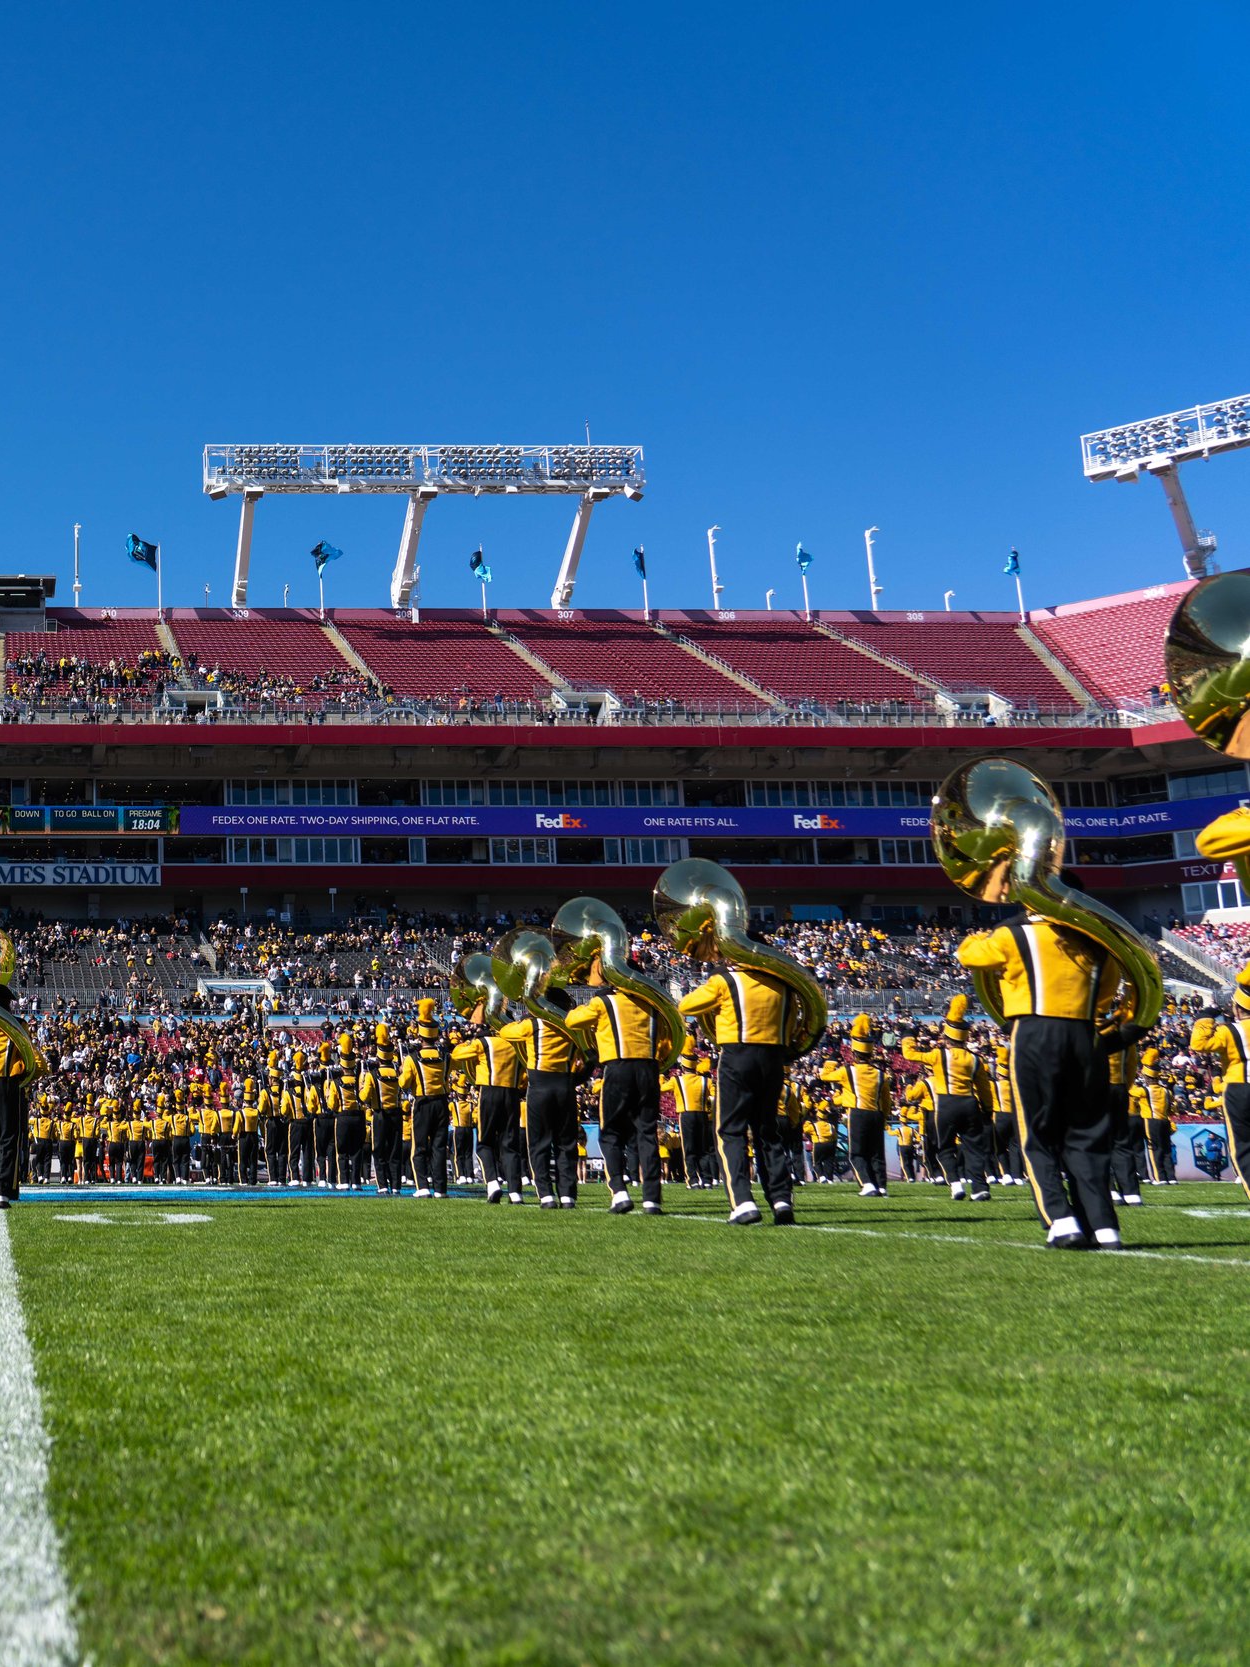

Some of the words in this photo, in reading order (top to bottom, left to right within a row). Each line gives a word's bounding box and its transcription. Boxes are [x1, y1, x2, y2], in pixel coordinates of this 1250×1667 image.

[101, 609, 117, 617] 310
[233, 609, 249, 618] 309
[396, 610, 412, 618] 308
[557, 611, 574, 619] 307
[718, 611, 736, 619] 306
[906, 612, 924, 620] 305
[15, 810, 40, 818] DOWN
[54, 810, 64, 818] TO
[66, 810, 77, 818] GO
[82, 810, 102, 818] BALL
[103, 810, 115, 818] ON
[129, 810, 162, 818] PREGAME
[132, 819, 161, 830] 18:04
[212, 816, 244, 824] FEDEX
[247, 816, 268, 824] ONE
[271, 816, 298, 824] RATE.
[300, 816, 348, 824] TWO-DAY
[351, 816, 400, 826] SHIPPING,
[402, 816, 424, 825] ONE
[426, 816, 449, 825] FLAT
[452, 816, 480, 825] RATE.
[536, 813, 581, 828] FedEx
[644, 818, 665, 826] ONE
[668, 818, 693, 826] RATE
[695, 818, 715, 826] FITS
[717, 818, 739, 826] ALL.
[793, 815, 840, 829] FedEx
[1086, 817, 1107, 828] ONE
[1108, 816, 1137, 828] FLAT
[1139, 814, 1172, 825] RATE.
[1180, 863, 1219, 877] TEXT
[52, 866, 159, 885] STADIUM
